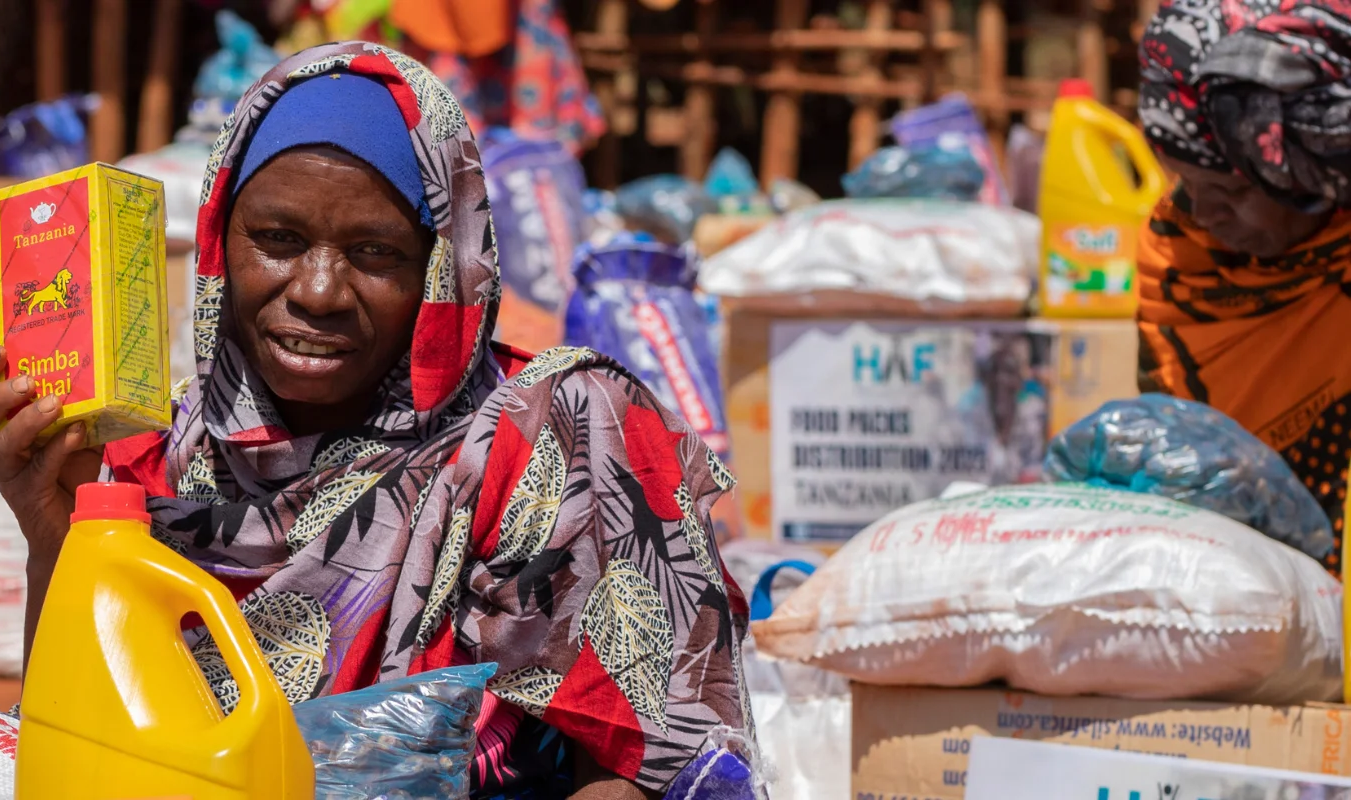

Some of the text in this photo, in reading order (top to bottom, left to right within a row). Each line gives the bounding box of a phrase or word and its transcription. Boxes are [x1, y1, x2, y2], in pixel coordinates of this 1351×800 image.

[13, 223, 75, 249] Tanzania
[8, 318, 45, 335] REGISTERED
[46, 315, 67, 326] TRADE
[18, 349, 80, 378] Simba
[790, 407, 911, 435] FOOD PACKS
[1171, 723, 1252, 749] Website:
